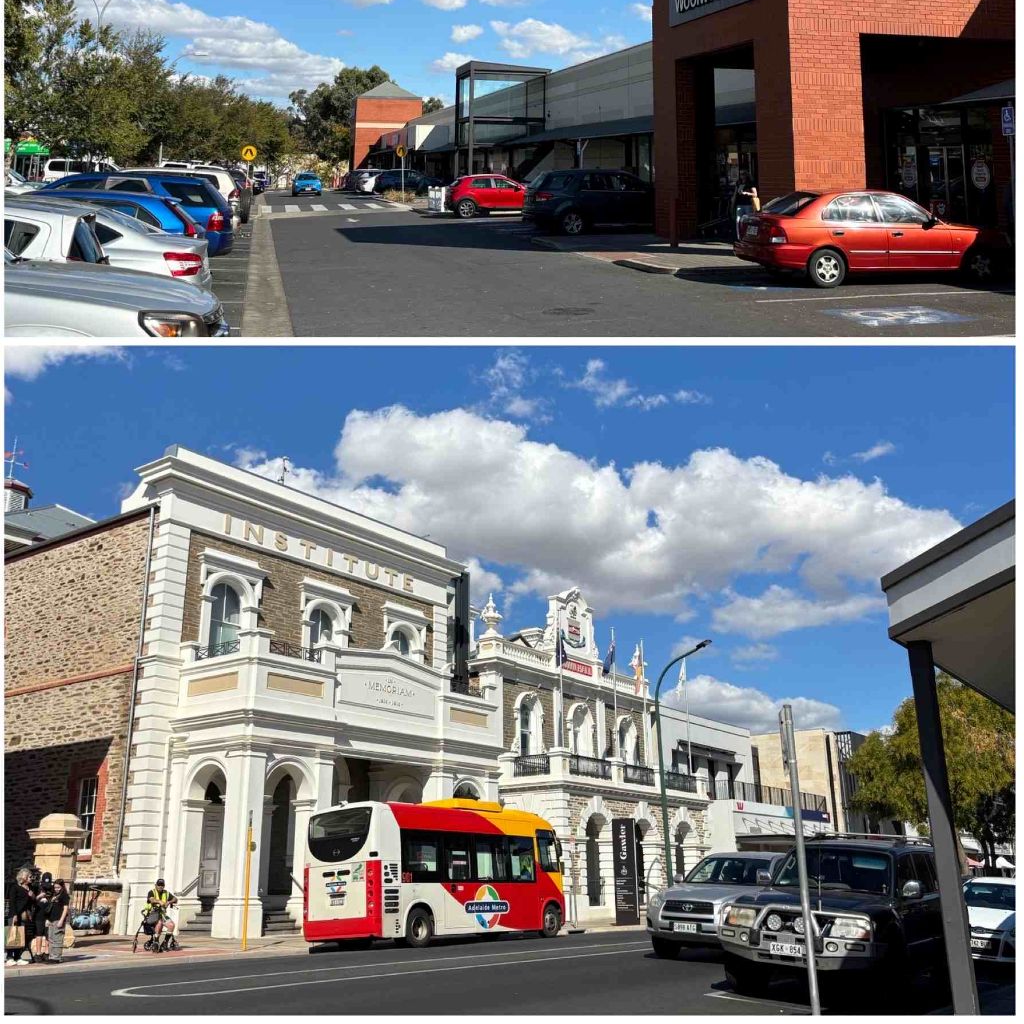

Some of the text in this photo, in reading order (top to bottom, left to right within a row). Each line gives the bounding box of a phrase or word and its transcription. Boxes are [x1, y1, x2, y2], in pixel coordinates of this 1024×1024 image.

[224, 513, 415, 593] INSTITUTE
[618, 824, 628, 860] Gawler
[467, 904, 490, 912] Adelaide
